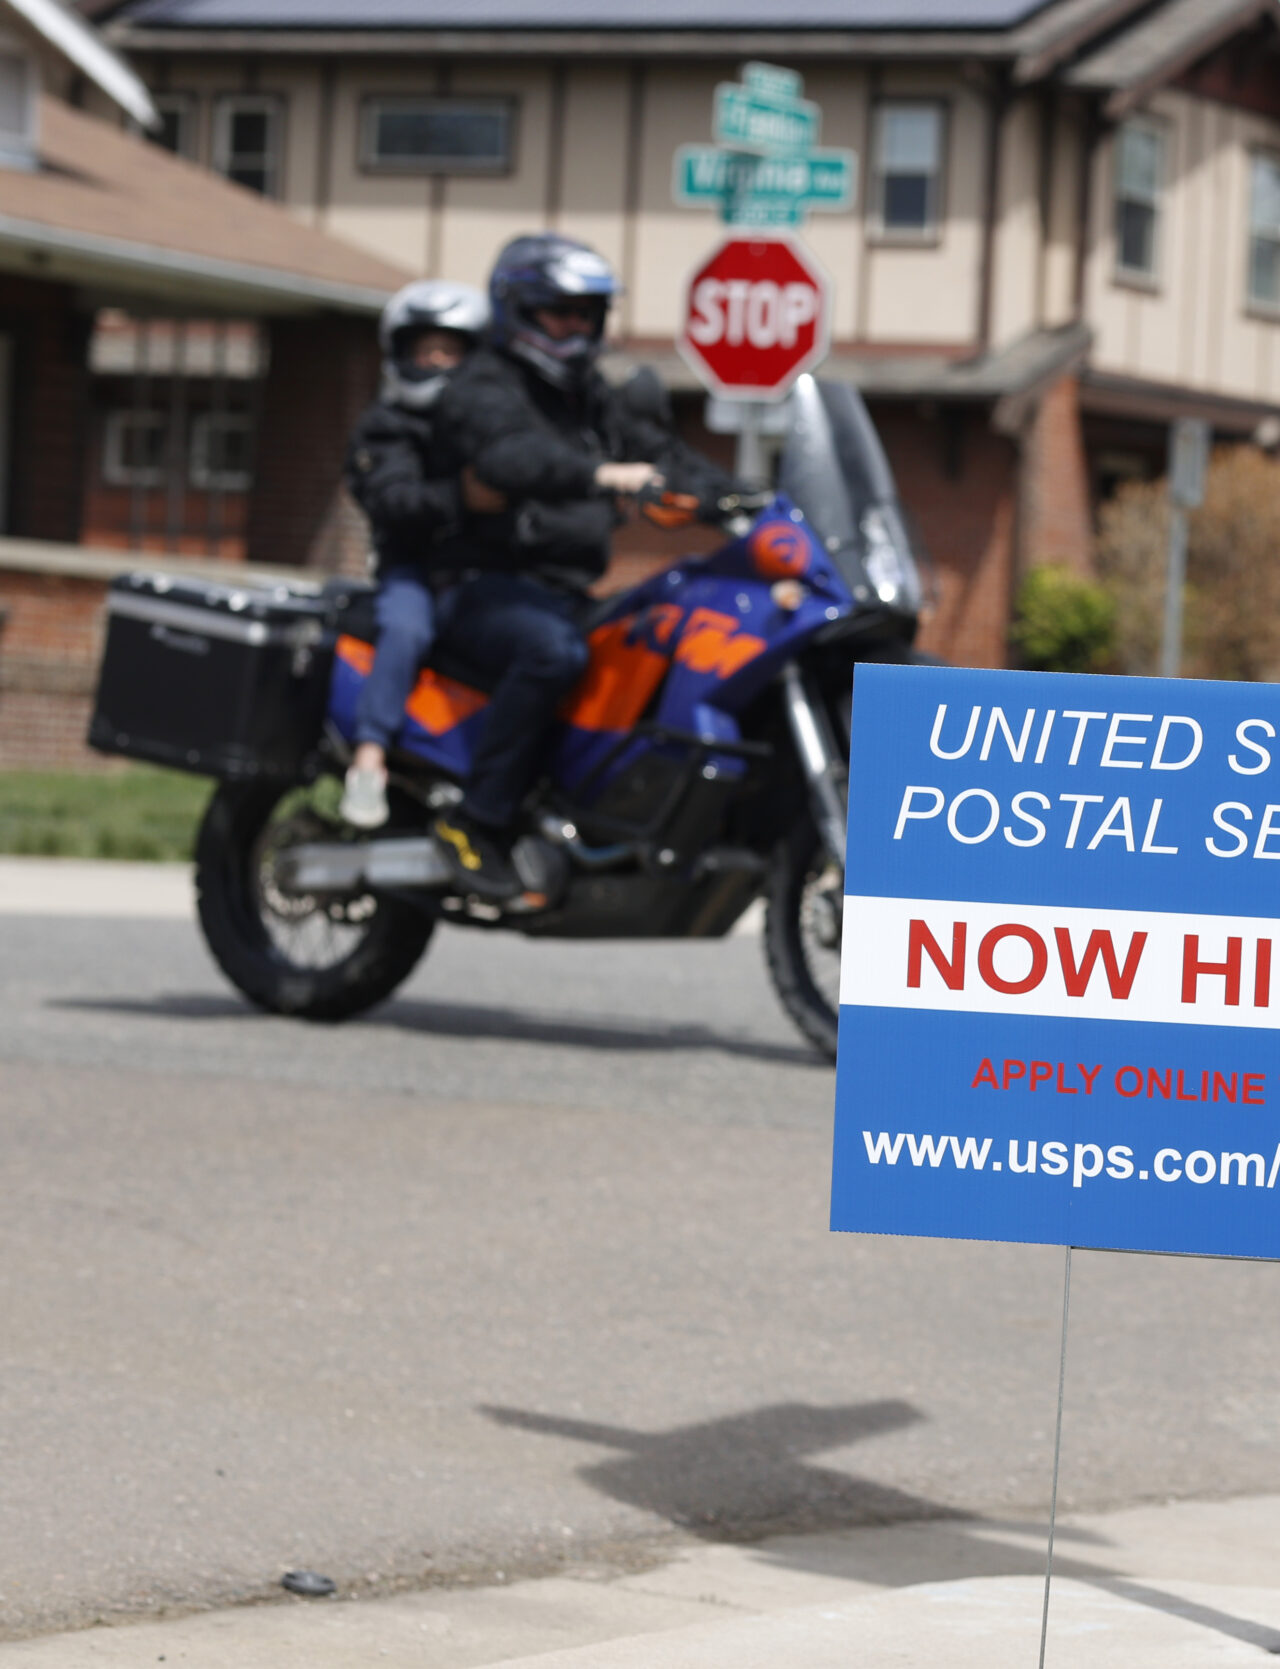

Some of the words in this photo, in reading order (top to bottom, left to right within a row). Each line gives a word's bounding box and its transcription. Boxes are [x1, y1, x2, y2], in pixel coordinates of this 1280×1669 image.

[688, 276, 819, 350] STOP
[929, 703, 1204, 771] UNITED
[893, 785, 1179, 855] POSTAL
[906, 919, 1148, 1000] NOW
[970, 1057, 1103, 1095] APPLY
[1114, 1065, 1266, 1105] ONLINE
